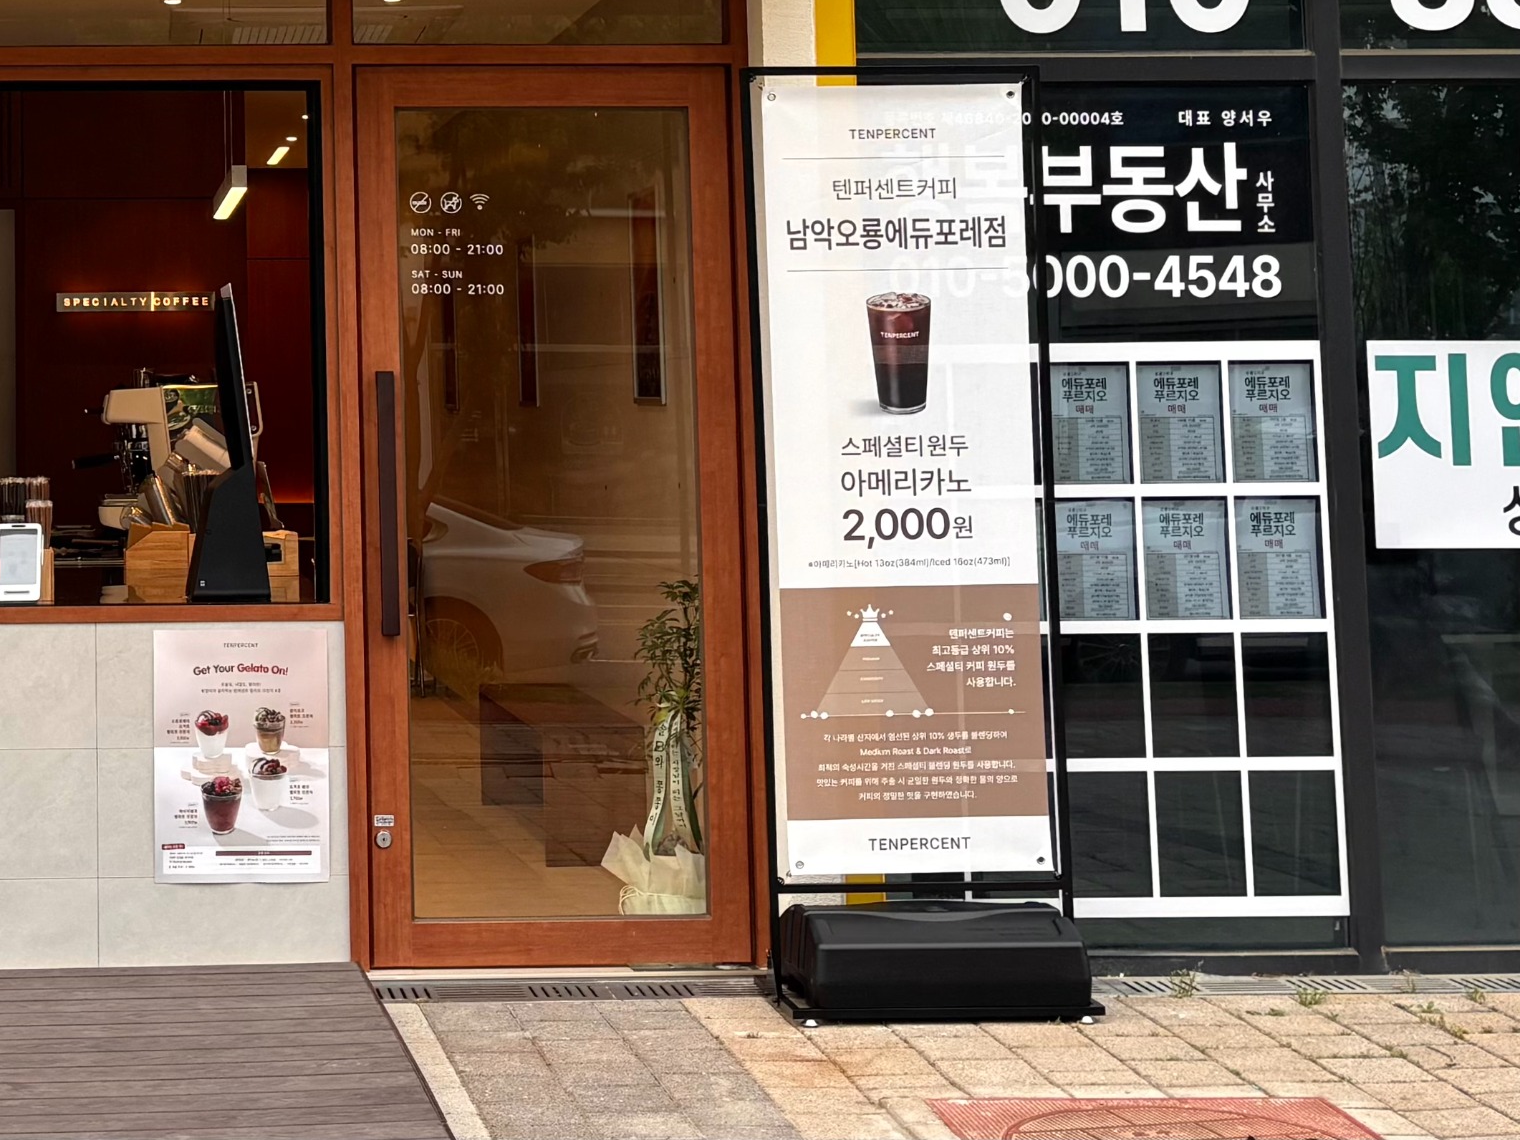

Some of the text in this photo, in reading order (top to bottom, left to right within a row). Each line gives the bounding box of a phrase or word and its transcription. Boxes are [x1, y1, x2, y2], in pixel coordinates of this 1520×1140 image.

[1178, 110, 1212, 126] 대표
[1221, 110, 1273, 126] 양서우
[849, 128, 936, 140] TENPERCENT
[832, 177, 958, 201] 텐퍼센트커피
[1256, 171, 1276, 233] 사무소
[411, 228, 434, 236] MON
[446, 228, 461, 236] FRI
[786, 216, 1007, 250] 남악오룡에듀포레점
[411, 244, 450, 255] 08:00
[467, 244, 504, 255] 21:00
[411, 270, 430, 278] SAT
[442, 270, 463, 278] SUN
[411, 284, 451, 294] 08:00
[468, 284, 504, 294] 21:00
[63, 296, 209, 307] SPECIALTY COFFEE
[1062, 377, 1107, 391] 에듀포레
[1154, 377, 1199, 390] 에듀포레
[1245, 376, 1290, 389] 에듀포레
[1062, 390, 1107, 403] 푸르지오
[1154, 390, 1199, 402] 푸르지오
[1246, 389, 1291, 402] 푸르지오
[841, 468, 972, 496] 아메리카노
[1066, 513, 1112, 527] 에듀포레
[1159, 512, 1204, 525] 에듀포레
[1250, 511, 1295, 525] 에듀포레
[842, 508, 974, 550] 2,000원
[1067, 525, 1112, 538] 푸르지오
[1159, 525, 1204, 538] 푸르지오
[1250, 525, 1296, 538] 푸르지오
[993, 644, 1015, 655] 10%
[193, 663, 288, 676] Get Your Gelato On!
[966, 661, 985, 672] 커피
[923, 747, 941, 755] Dark
[868, 836, 971, 851] TENPERCENT
